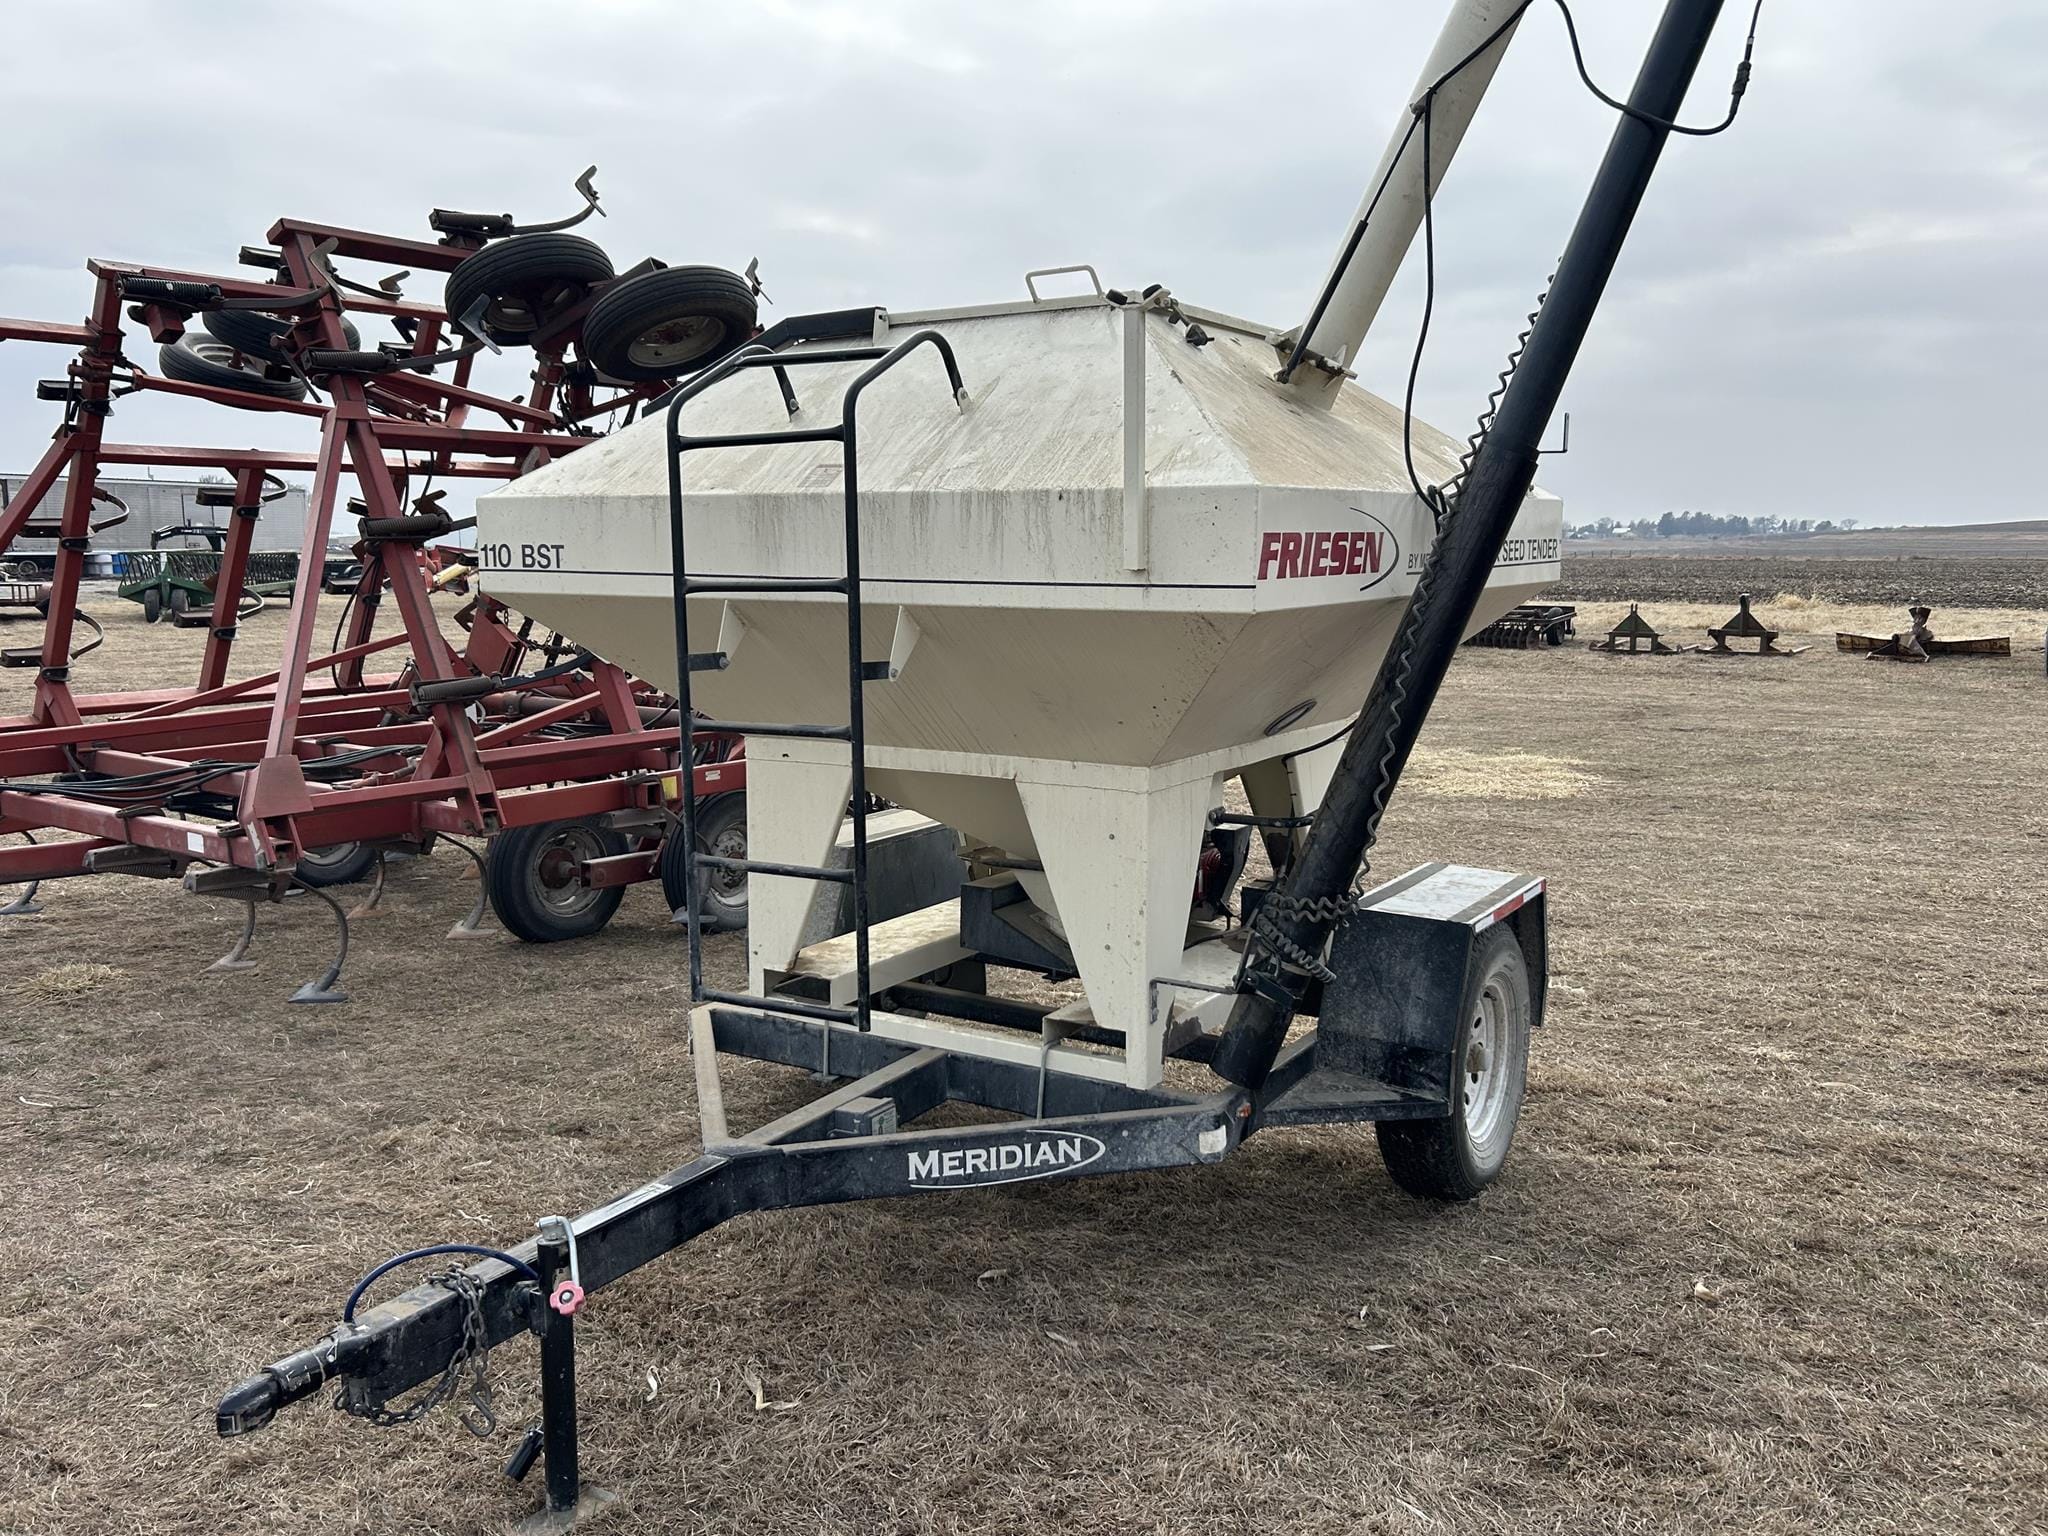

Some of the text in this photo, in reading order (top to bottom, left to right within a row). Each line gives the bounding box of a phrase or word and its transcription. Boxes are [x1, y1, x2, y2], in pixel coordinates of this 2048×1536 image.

[480, 543, 565, 569] 110 BST
[1257, 531, 1385, 580] FRIESEN
[1407, 553, 1419, 569] BY
[1502, 538, 1558, 562] SEED TENDER
[907, 1137, 1082, 1181] MERIDIAN
